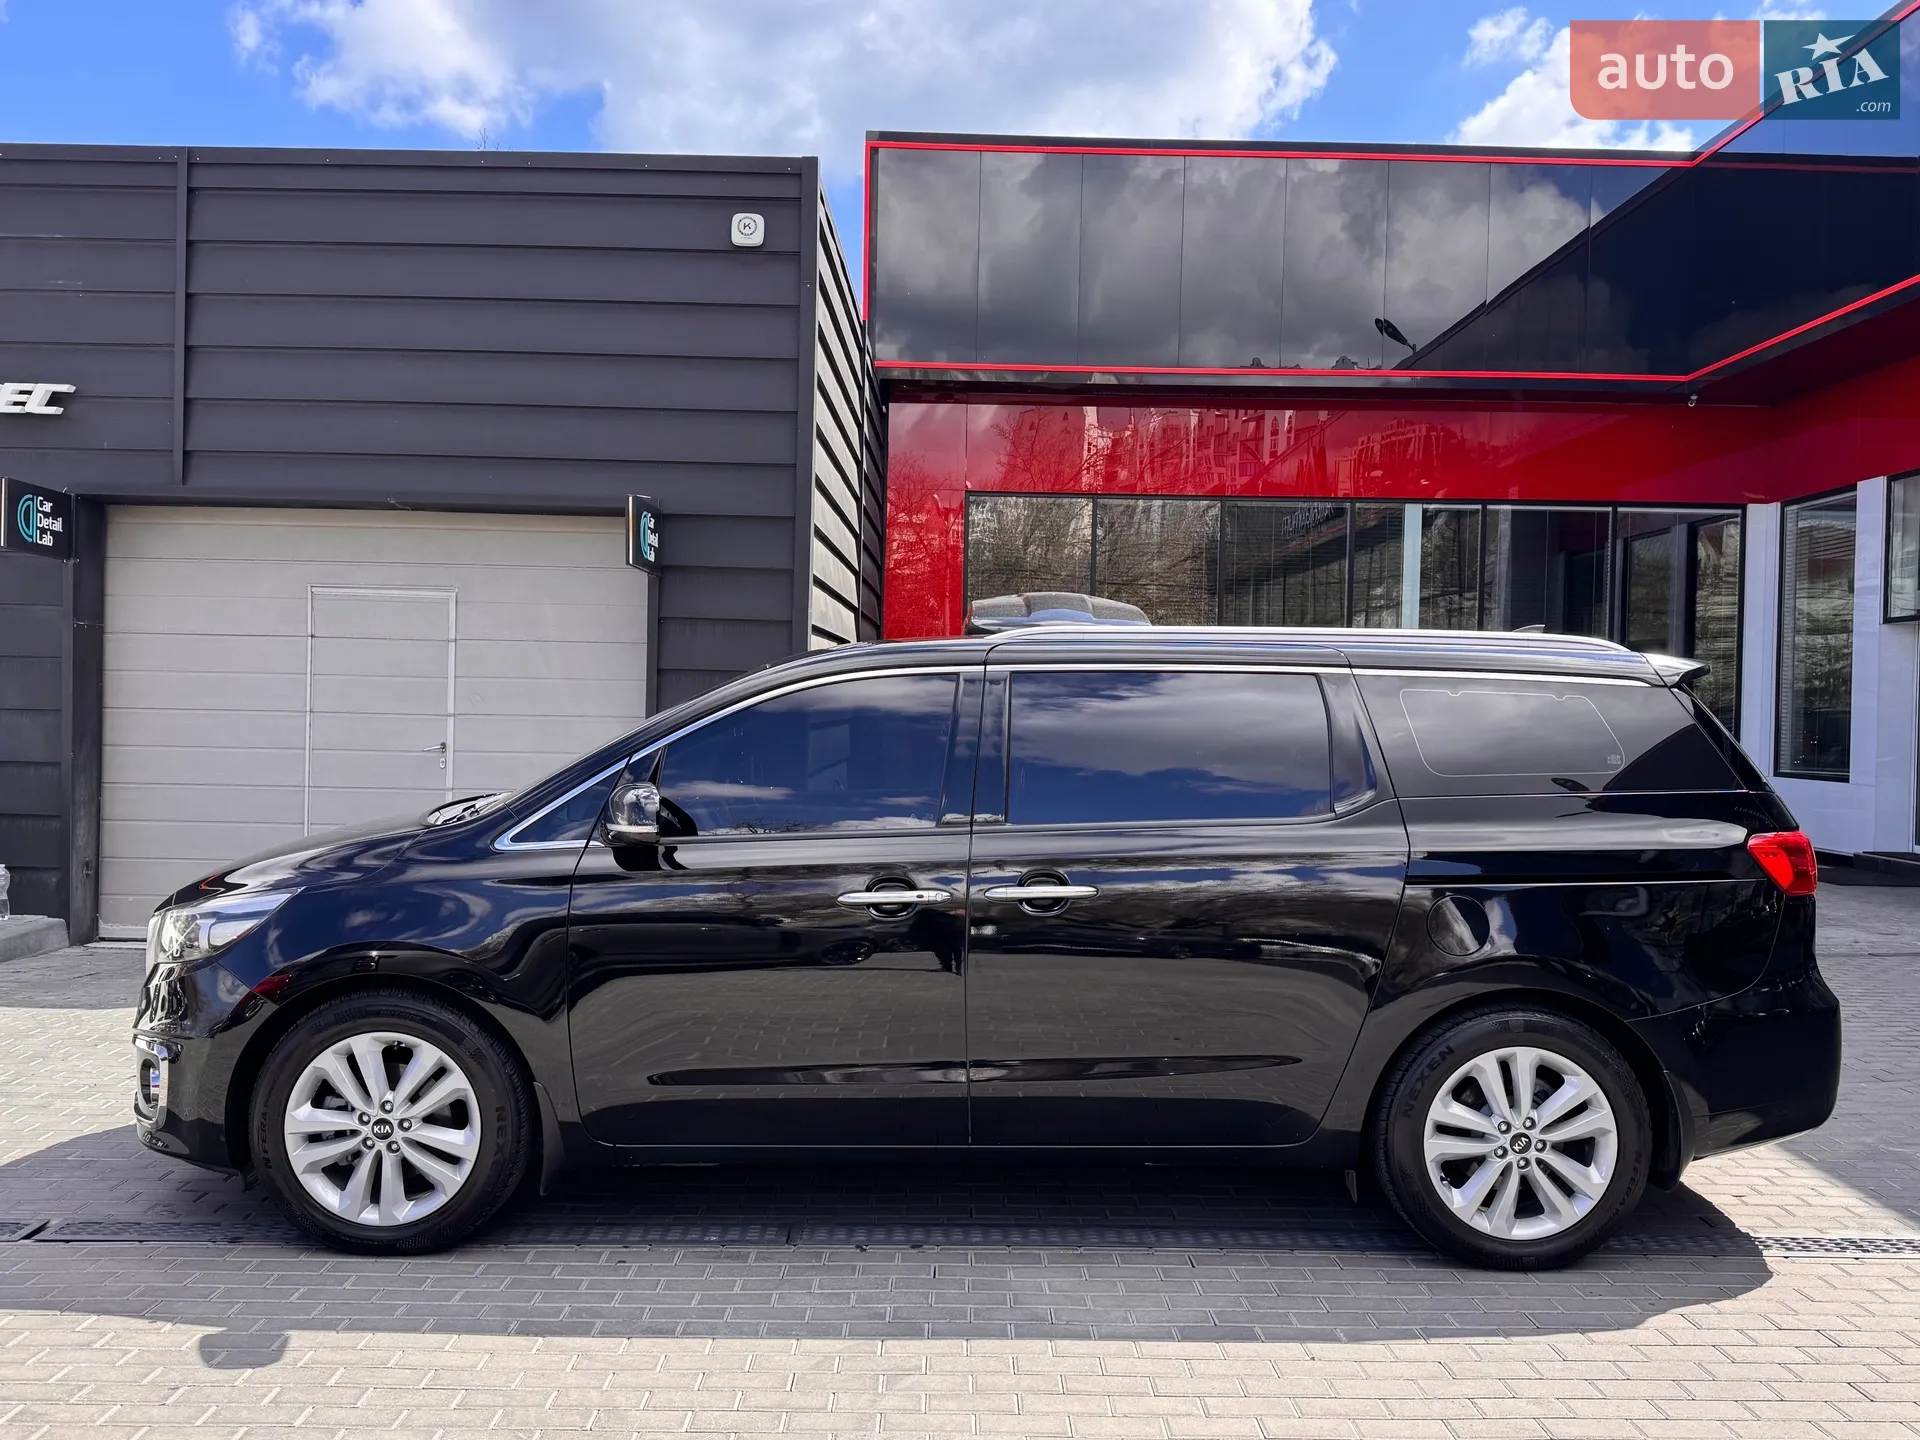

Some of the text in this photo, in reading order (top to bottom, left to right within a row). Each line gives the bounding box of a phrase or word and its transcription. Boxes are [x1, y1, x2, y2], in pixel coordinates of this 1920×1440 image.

[0, 383, 76, 414] EC
[37, 496, 53, 513] Car
[37, 513, 63, 532] Detail
[37, 532, 54, 547] Lab
[373, 1125, 391, 1134] KIA
[1512, 1136, 1529, 1152] KIA
